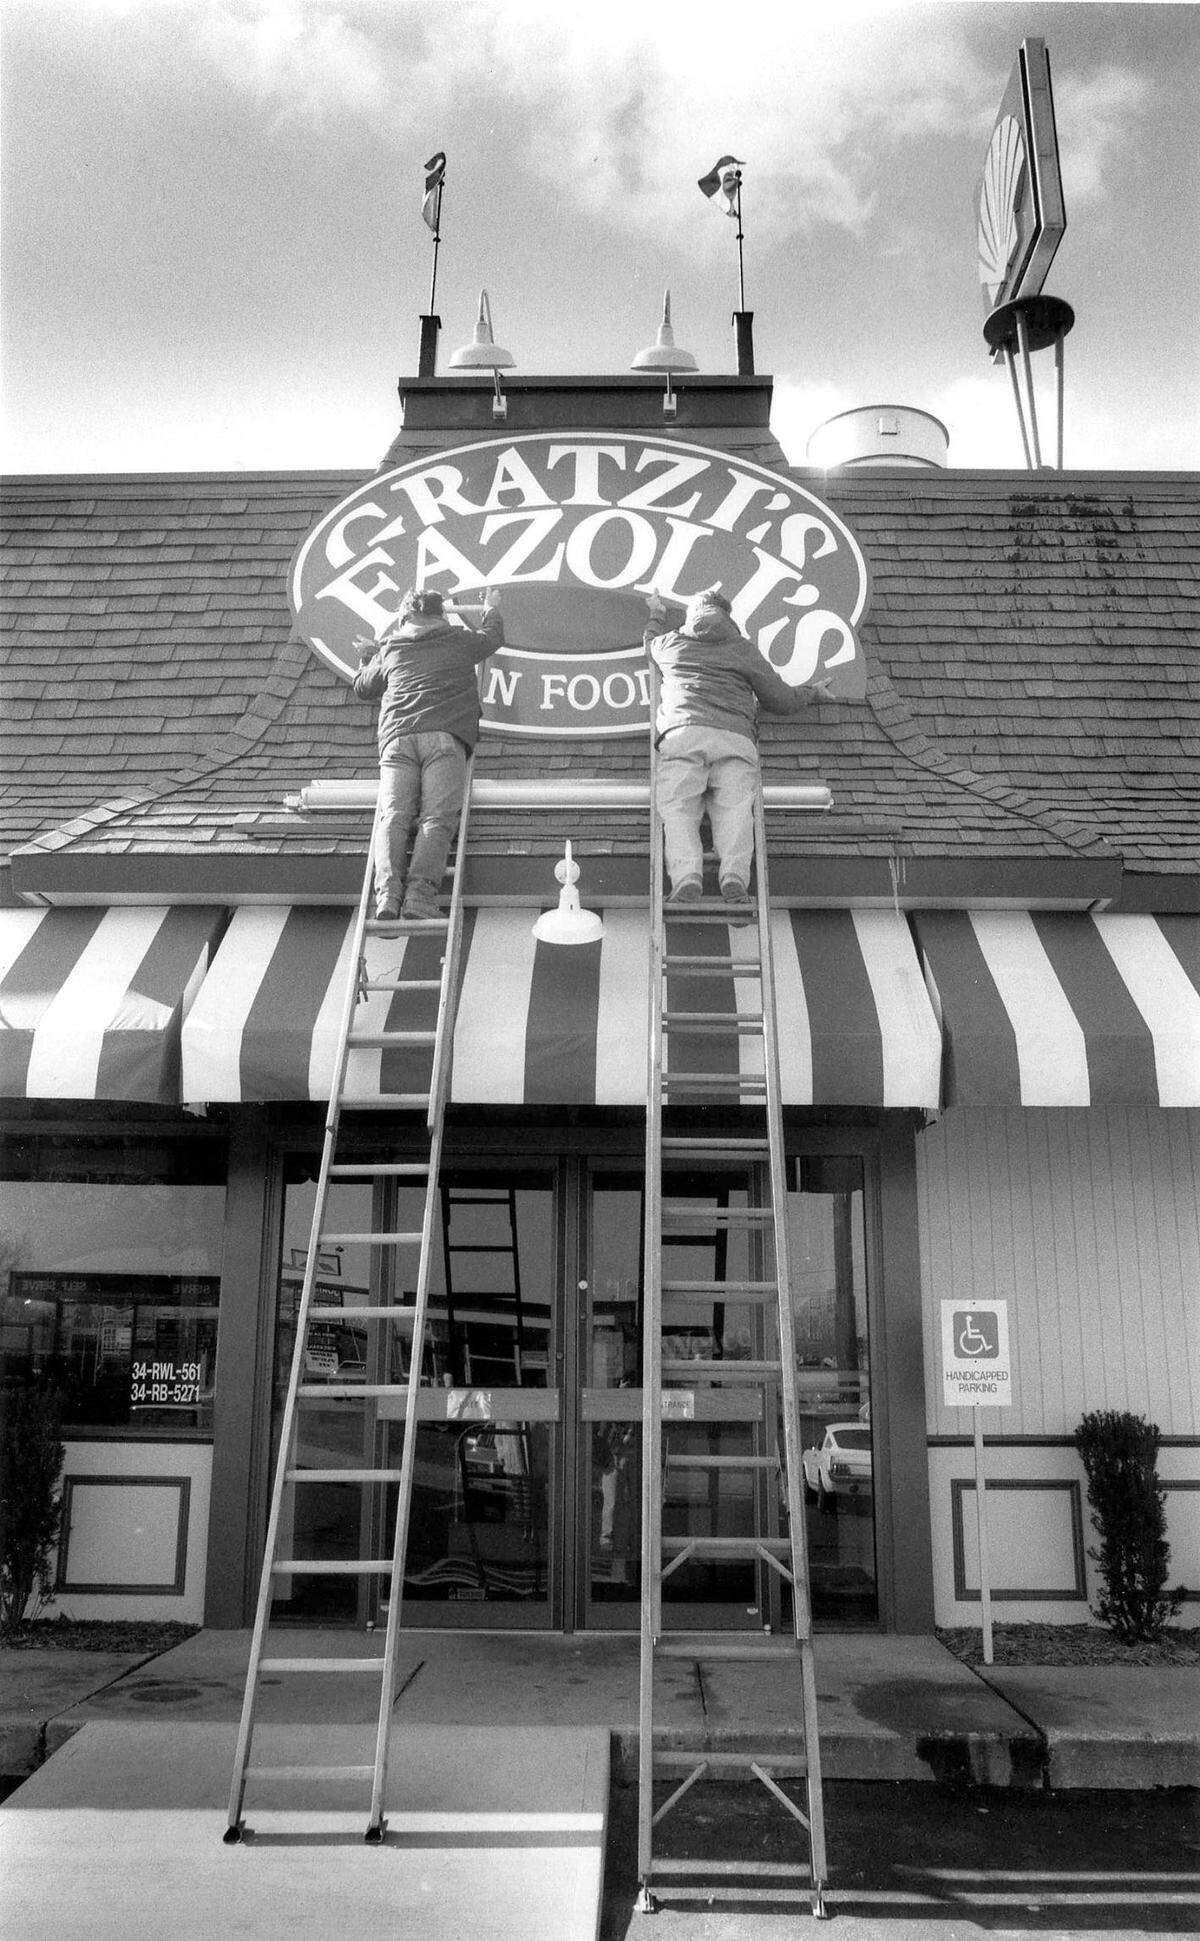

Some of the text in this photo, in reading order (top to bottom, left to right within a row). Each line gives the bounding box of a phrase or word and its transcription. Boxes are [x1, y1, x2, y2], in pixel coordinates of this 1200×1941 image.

[326, 445, 838, 569] GRATZI'S
[315, 508, 856, 687] FAZOLI'S
[131, 1362, 201, 1381] 34-RWL-561
[946, 1371, 1008, 1381] HANDICAPPED
[130, 1383, 200, 1402] 34-RB-5271
[958, 1383, 998, 1393] PARKING
